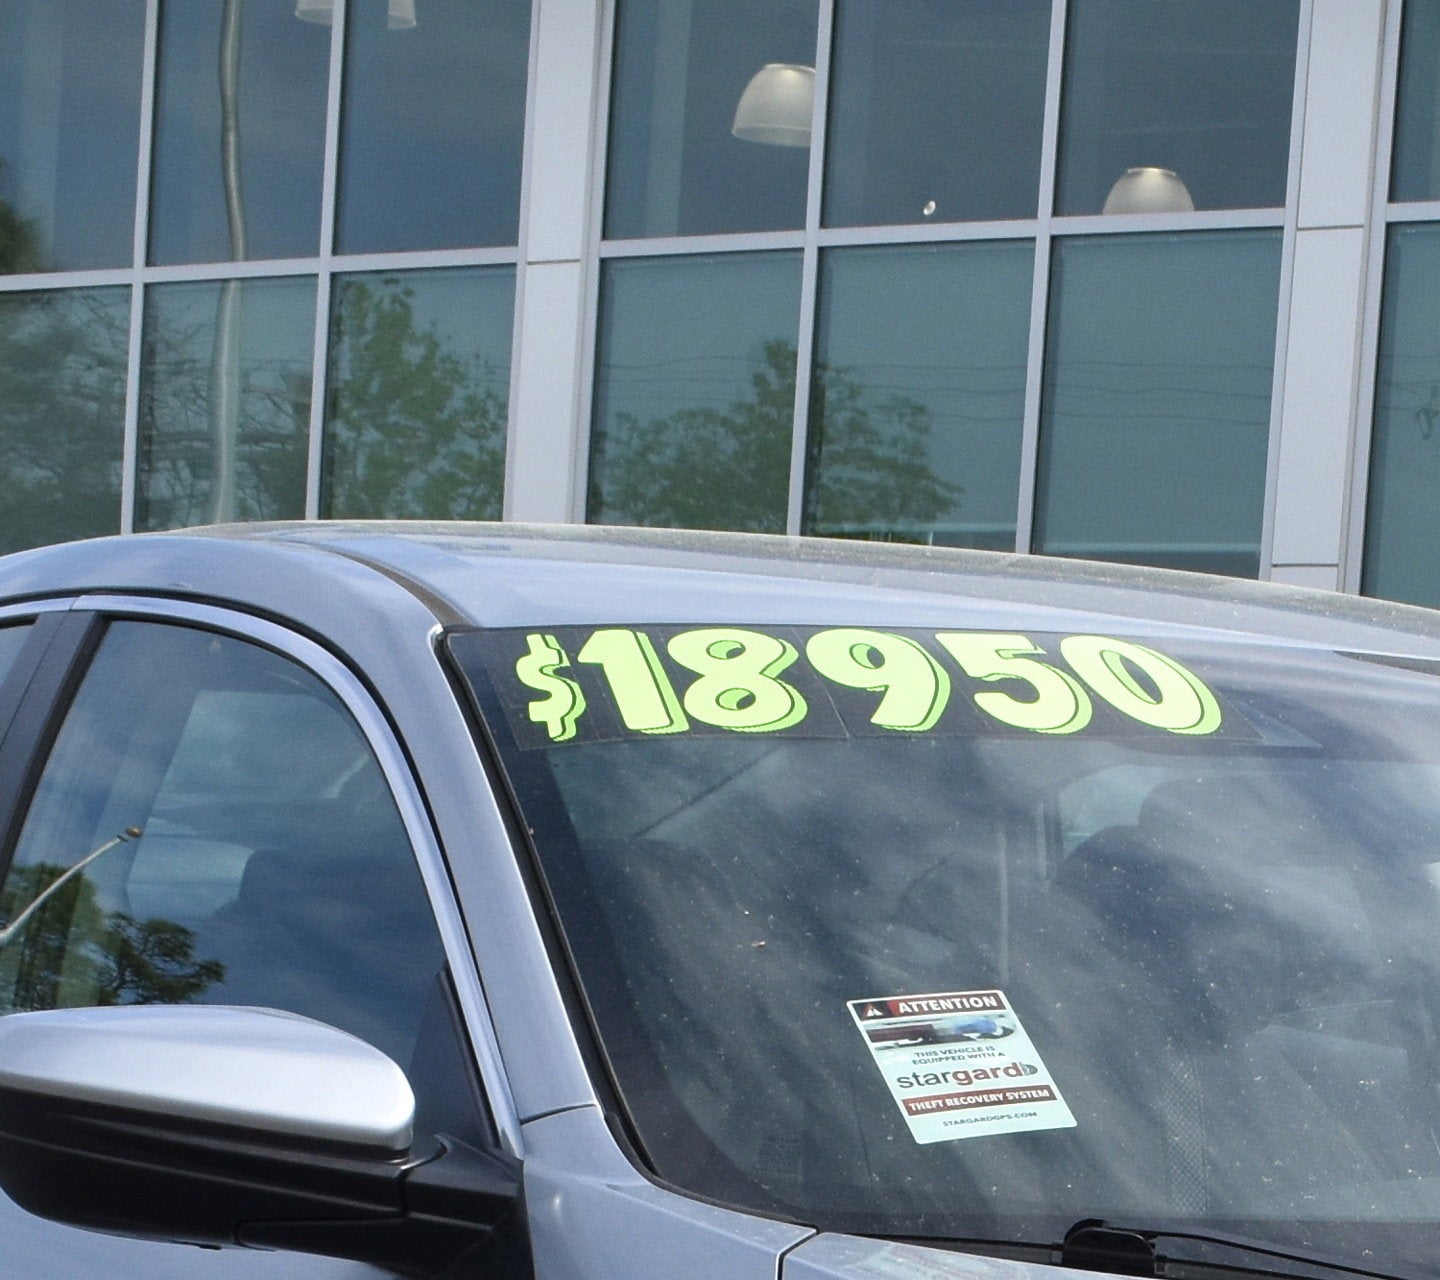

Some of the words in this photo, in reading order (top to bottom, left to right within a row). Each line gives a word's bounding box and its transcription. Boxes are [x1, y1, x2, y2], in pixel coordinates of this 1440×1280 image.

[515, 627, 1222, 742] $18950
[898, 996, 998, 1014] ATTENTION
[912, 1055, 966, 1066] EQUIPPED
[966, 1052, 996, 1061] WITH
[914, 1050, 938, 1058] THIS
[939, 1046, 983, 1056] VEHICLE
[896, 1061, 1022, 1089] stargard
[908, 1099, 945, 1112] THEFT
[945, 1092, 1005, 1107] RECOVERY
[1005, 1089, 1050, 1100] SYSTEM
